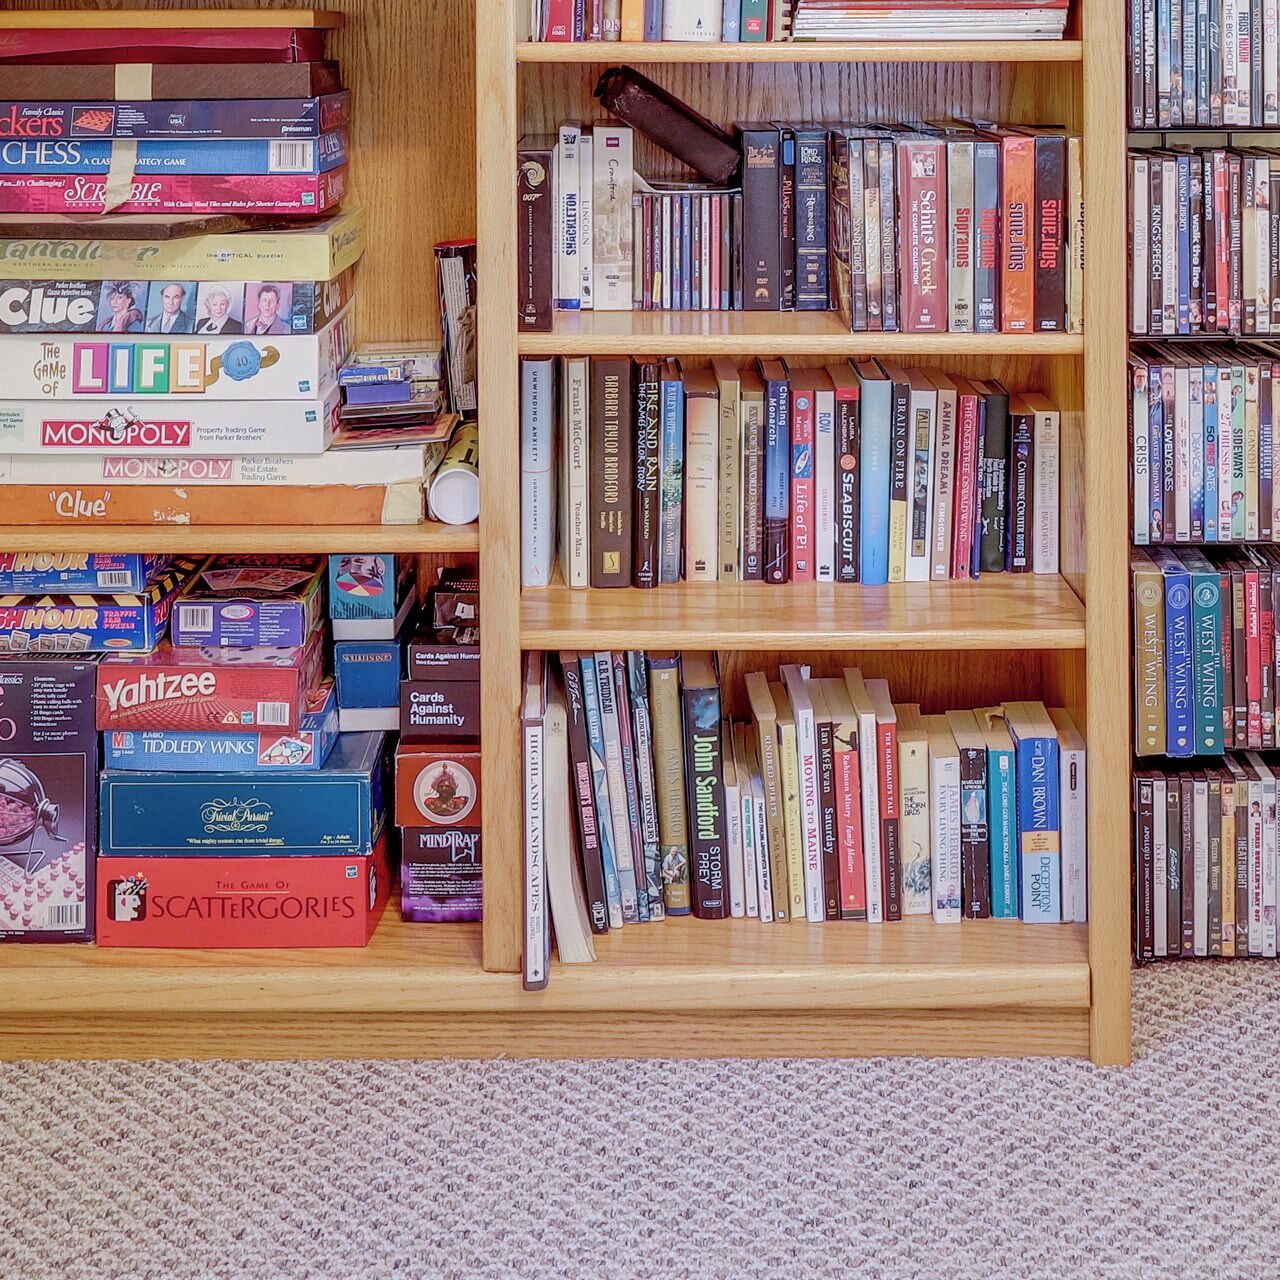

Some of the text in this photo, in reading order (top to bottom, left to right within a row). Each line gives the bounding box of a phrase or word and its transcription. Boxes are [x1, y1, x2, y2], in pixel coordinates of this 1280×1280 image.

[2, 141, 81, 165] CHESS
[566, 193, 576, 256] SHACKLETON
[920, 247, 937, 295] Creek
[79, 348, 208, 388] LIFE
[572, 379, 581, 471] Frank McCourt
[604, 375, 619, 503] BARBARA TAYLOR BRADFORD
[645, 382, 658, 491] FIRE AND RAIN
[895, 398, 906, 488] BRAIN ON FIRE
[1136, 435, 1147, 474] CRISIS
[1233, 428, 1243, 478] SIDEWAYS
[49, 490, 112, 518] "Clue"
[842, 473, 854, 561] SEABISCUIT
[22, 604, 98, 630] HOUR
[1174, 616, 1187, 709] WEST WING
[103, 672, 216, 712] Yahtzee
[410, 692, 445, 703] Cards
[410, 702, 454, 716] Against
[410, 713, 465, 726] Humanity
[142, 739, 255, 755] TIDDLEDY WINKS
[693, 735, 719, 841] John Sandford
[1033, 757, 1046, 828] DAN BROWN
[825, 807, 834, 854] Saturday
[697, 852, 709, 884] PREY
[709, 845, 725, 891] STORM
[1040, 857, 1051, 913] DECEPTION
[152, 896, 355, 919] SCATTERGORIES
[1030, 874, 1042, 909] POINT
